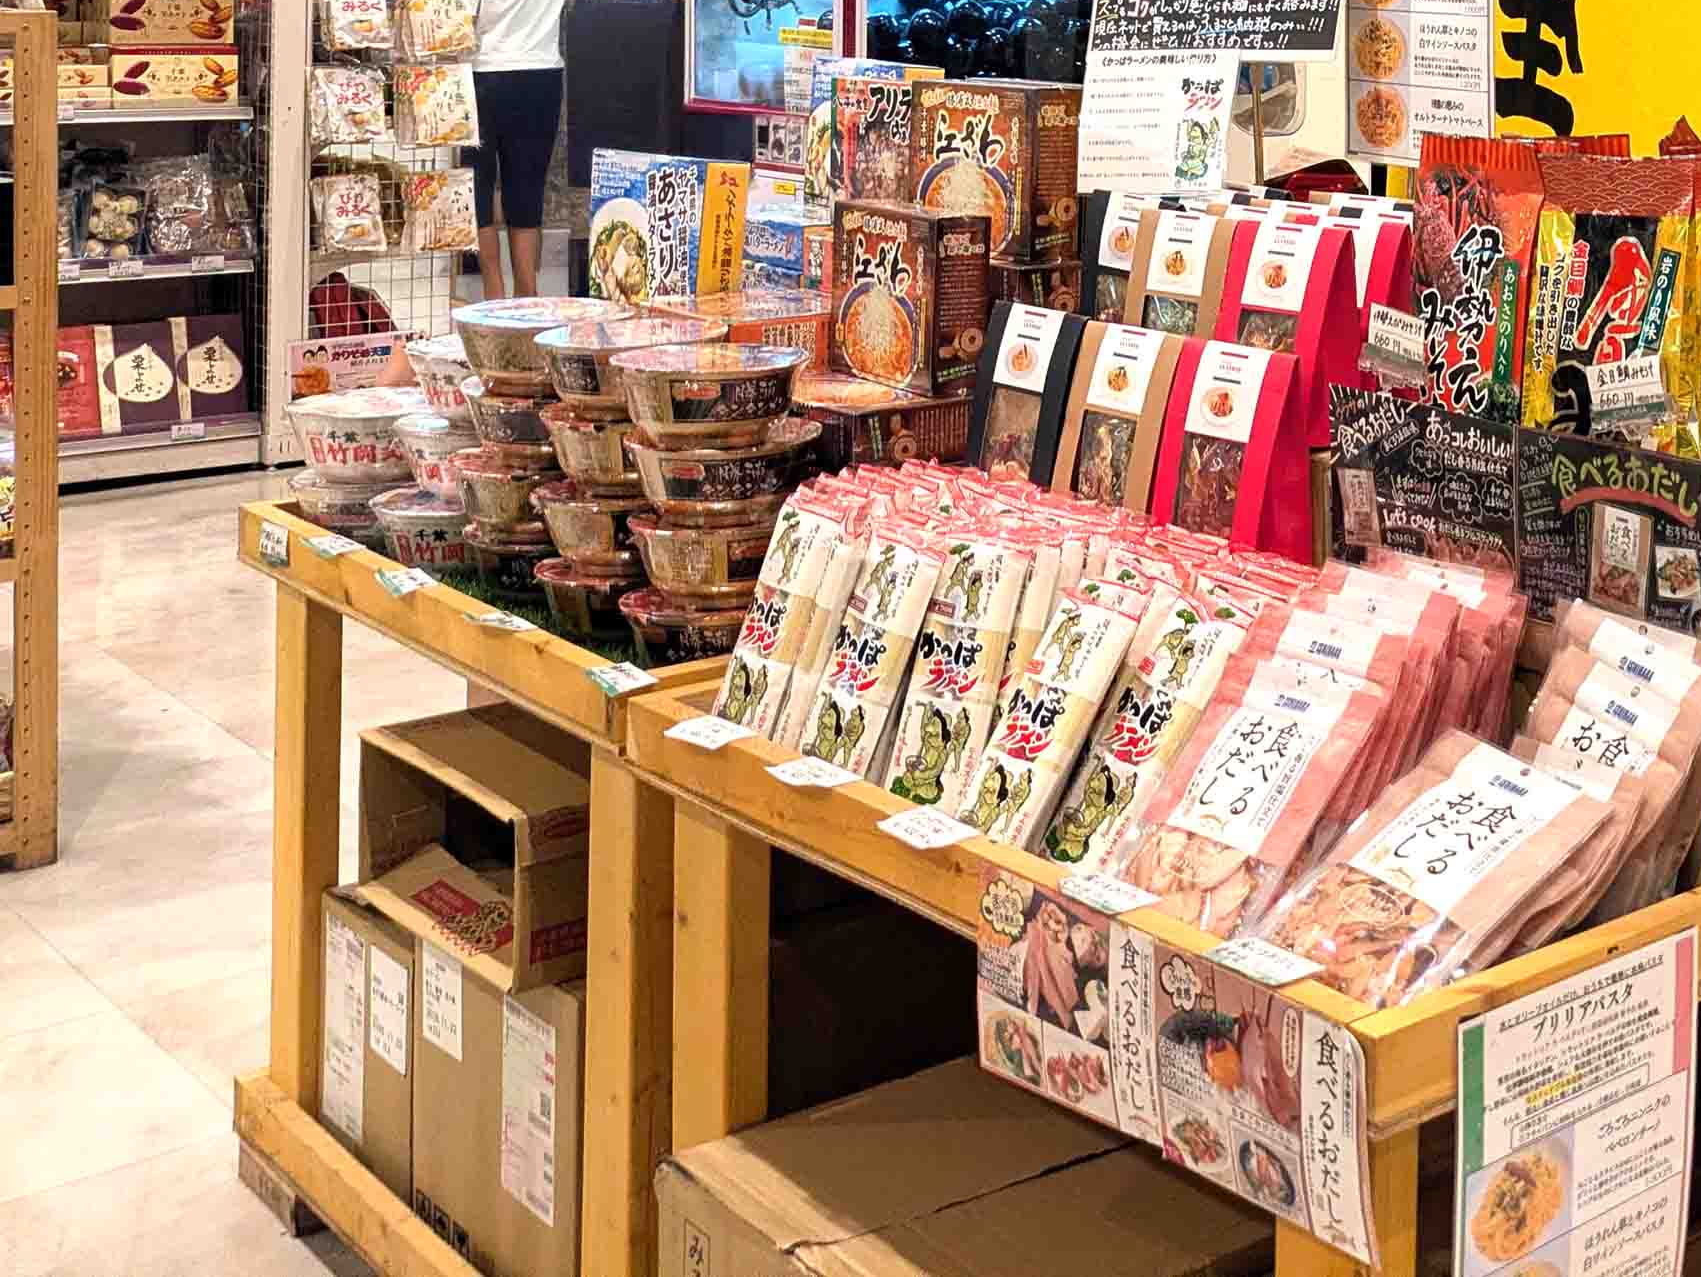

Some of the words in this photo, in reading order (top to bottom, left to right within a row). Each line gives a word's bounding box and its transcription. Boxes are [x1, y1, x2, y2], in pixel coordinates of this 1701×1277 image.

[657, 167, 677, 280] あさり
[1645, 256, 1673, 341] 岩のり風味
[1551, 452, 1698, 516] 食べるおだし
[835, 623, 887, 665] かっぱ
[919, 630, 983, 668] かっぱ
[1008, 687, 1066, 728] かっぱ
[1116, 686, 1173, 734] かっぱ
[1119, 938, 1146, 1111] 食べるおだし
[1533, 984, 1634, 1042] ブリリアパスタ
[1315, 1031, 1342, 1228] 食べるおだし
